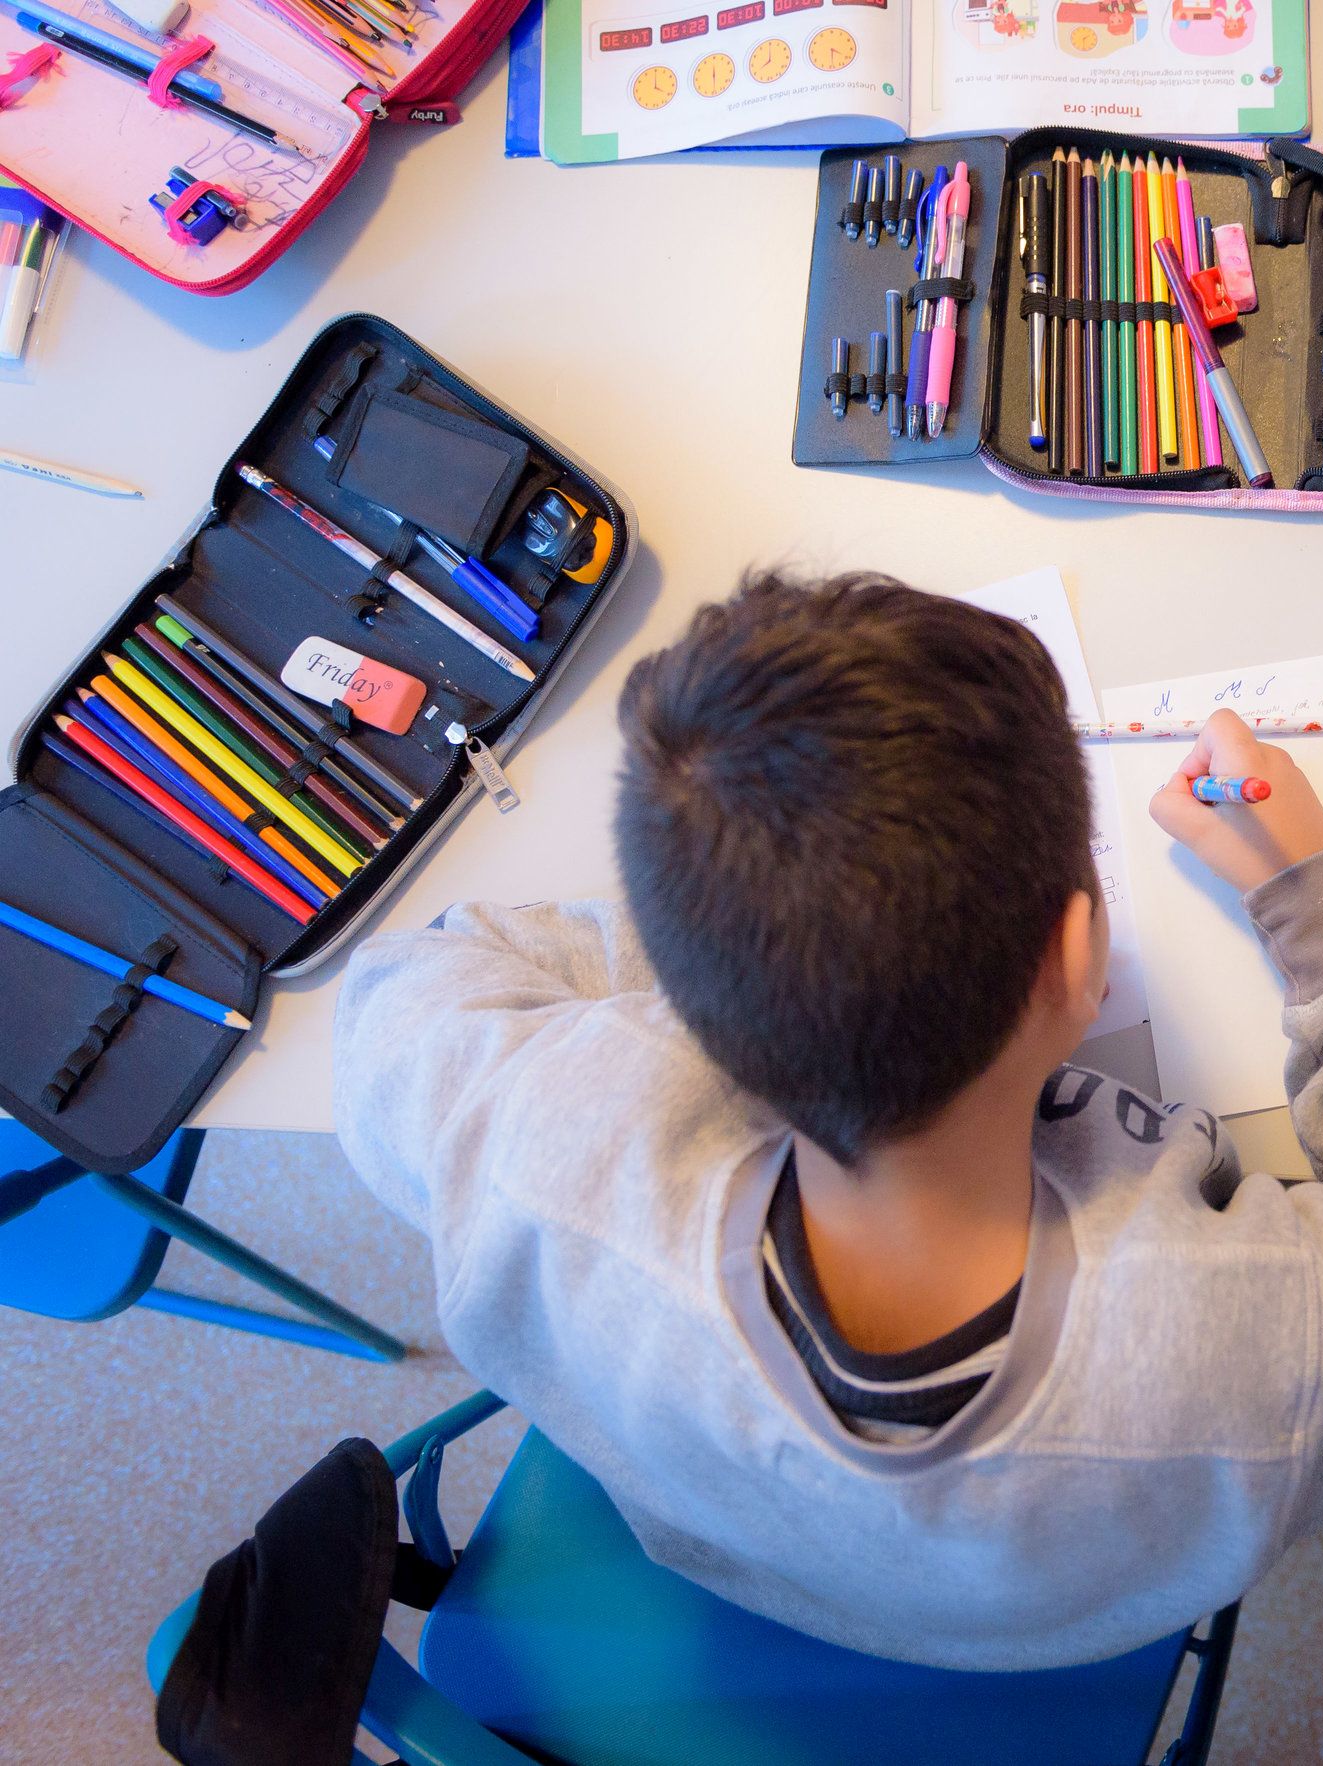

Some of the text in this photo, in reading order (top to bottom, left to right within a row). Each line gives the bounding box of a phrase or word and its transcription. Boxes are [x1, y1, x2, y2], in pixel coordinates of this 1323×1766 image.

[601, 30, 649, 48] 14:30
[1081, 77, 1098, 85] Ada
[792, 86, 808, 96] care
[411, 109, 444, 122] Furby
[1063, 103, 1142, 119] Timpul: ora
